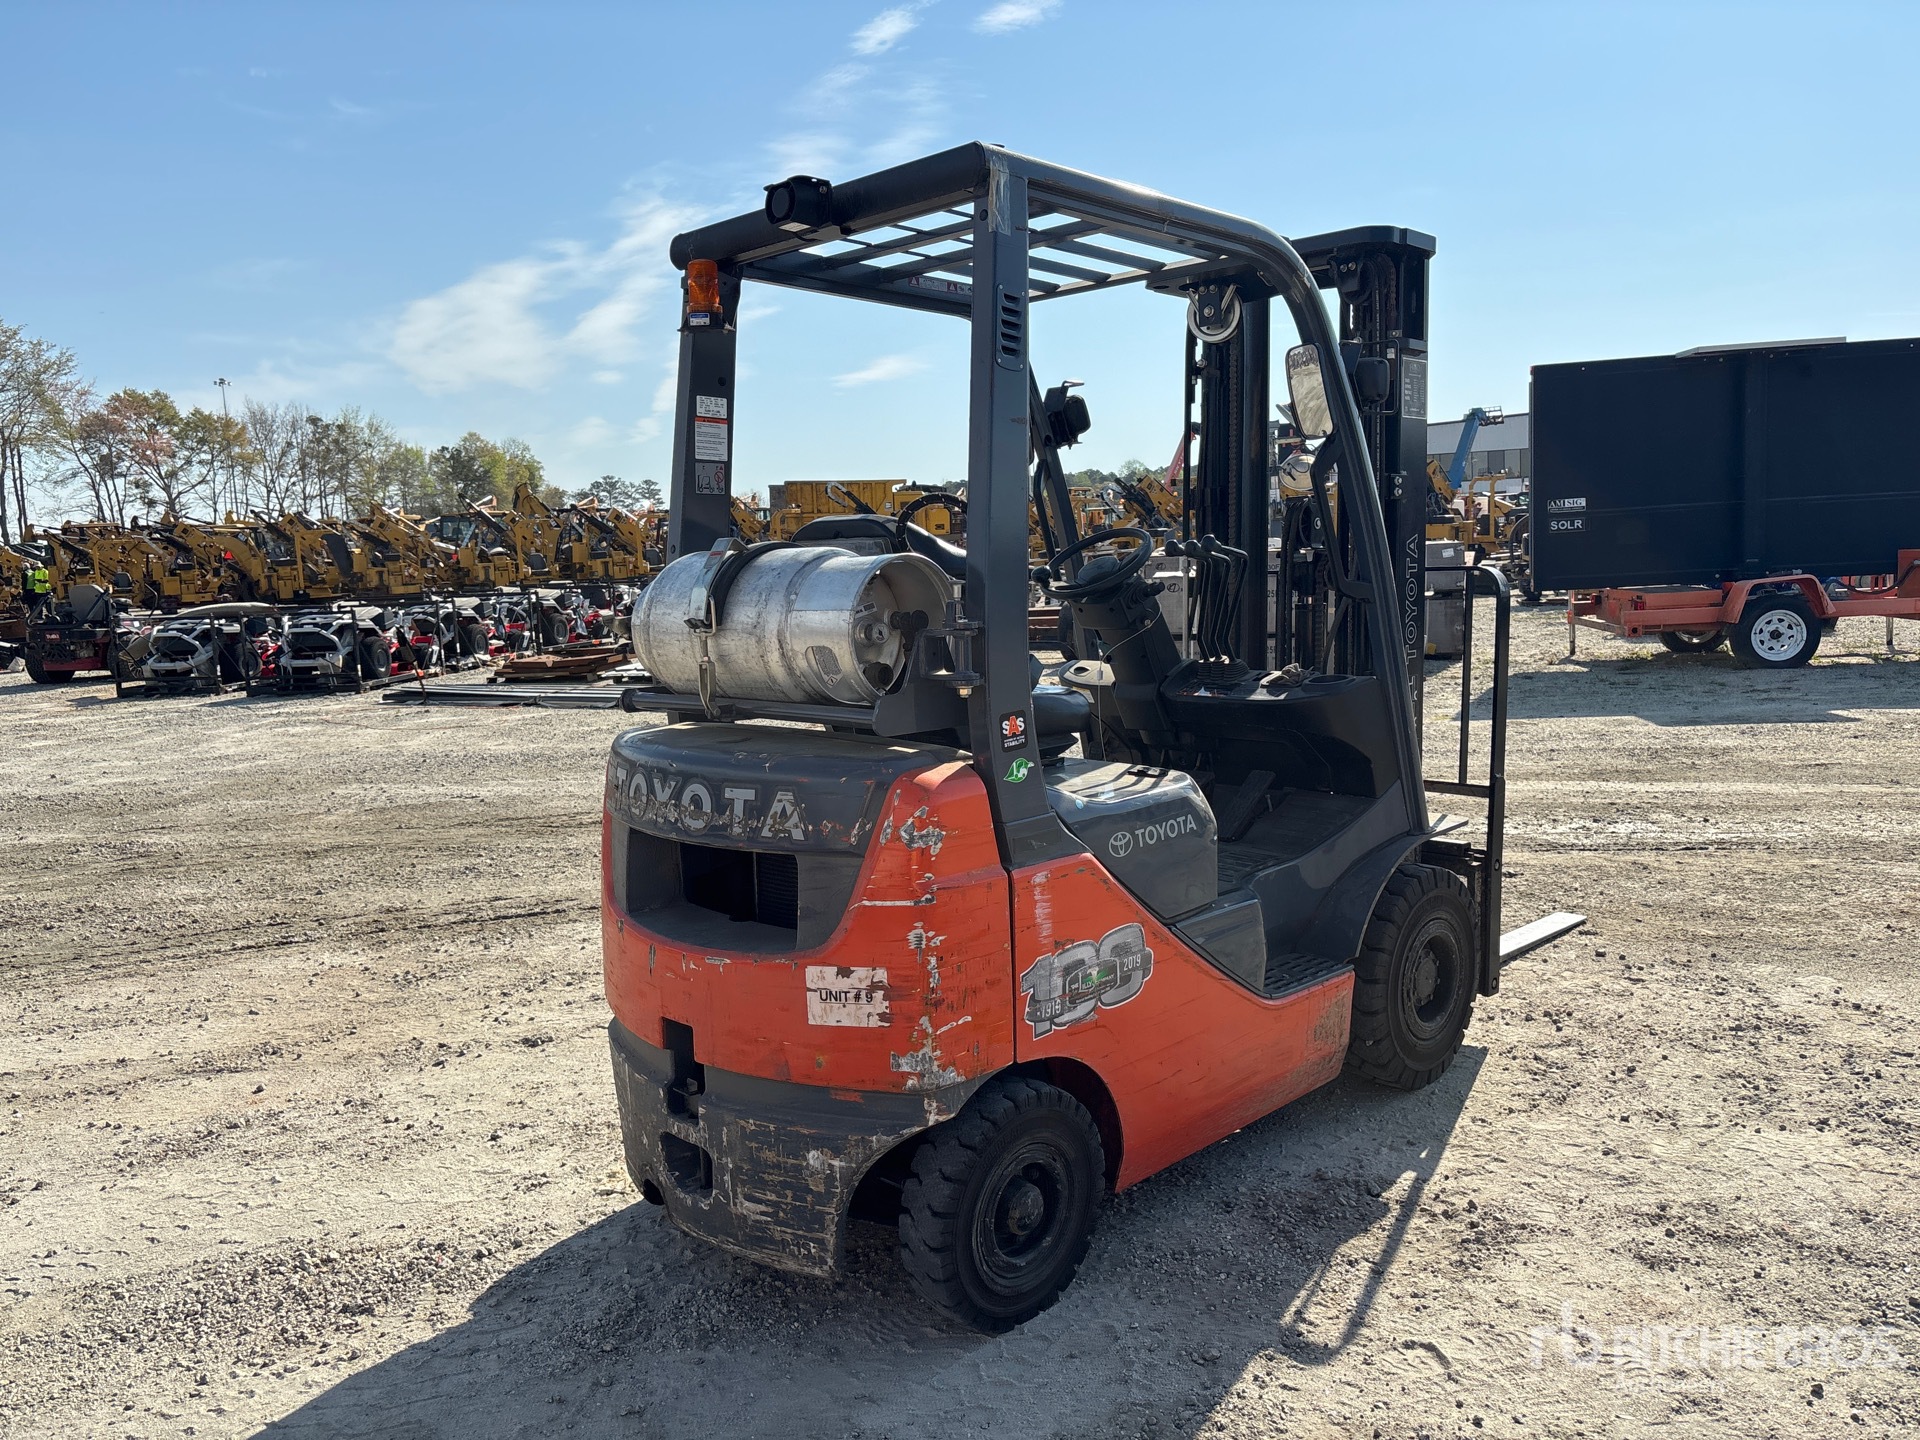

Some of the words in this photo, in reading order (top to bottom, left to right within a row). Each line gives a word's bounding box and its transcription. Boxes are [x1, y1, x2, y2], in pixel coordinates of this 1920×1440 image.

[1550, 519, 1583, 530] SOLR
[1404, 533, 1419, 665] TOYOTA
[1002, 715, 1025, 737] SAS
[615, 765, 806, 842] TOYOTA
[1134, 813, 1198, 848] TOYOTA
[1123, 953, 1142, 972] 2019
[819, 989, 850, 1003] UNIT
[853, 991, 862, 1003] #
[865, 991, 874, 1004] 9
